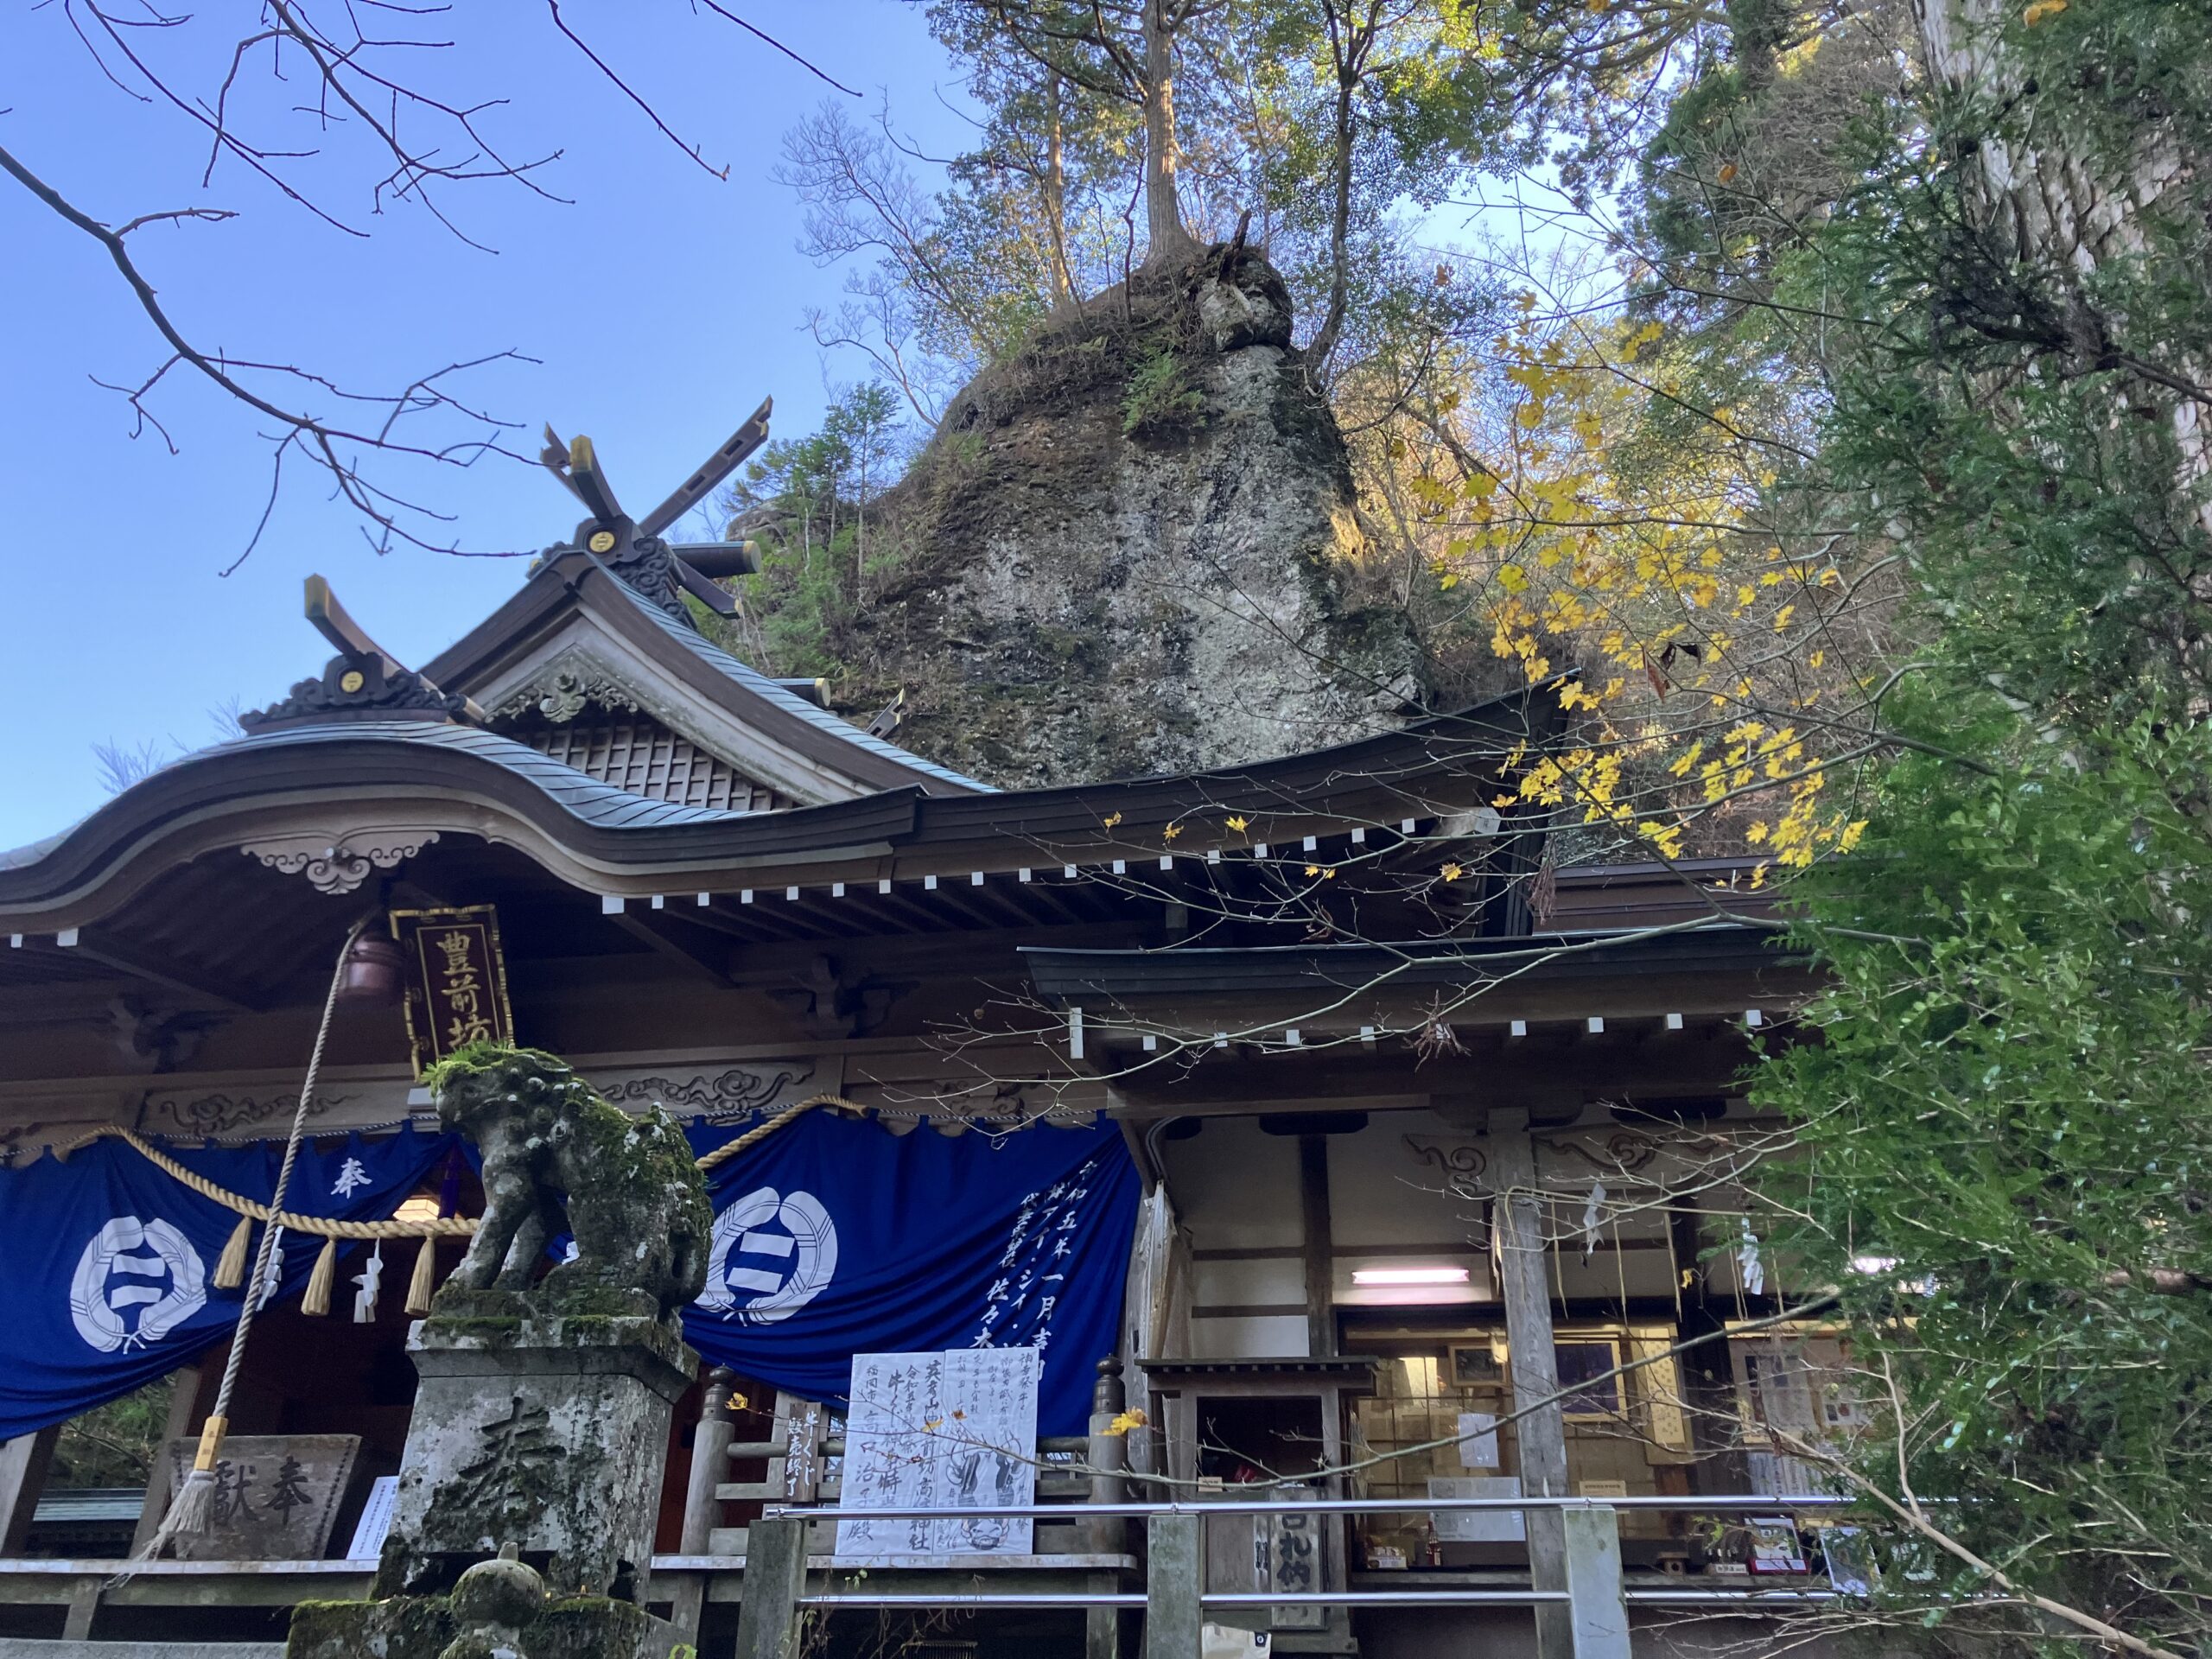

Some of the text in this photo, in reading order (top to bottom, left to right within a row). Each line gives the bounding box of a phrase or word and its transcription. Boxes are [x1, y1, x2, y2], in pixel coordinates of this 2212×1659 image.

[330, 1157, 373, 1200] 奉
[785, 1417, 805, 1497] 販売終了
[803, 1410, 819, 1486] 牛くじ
